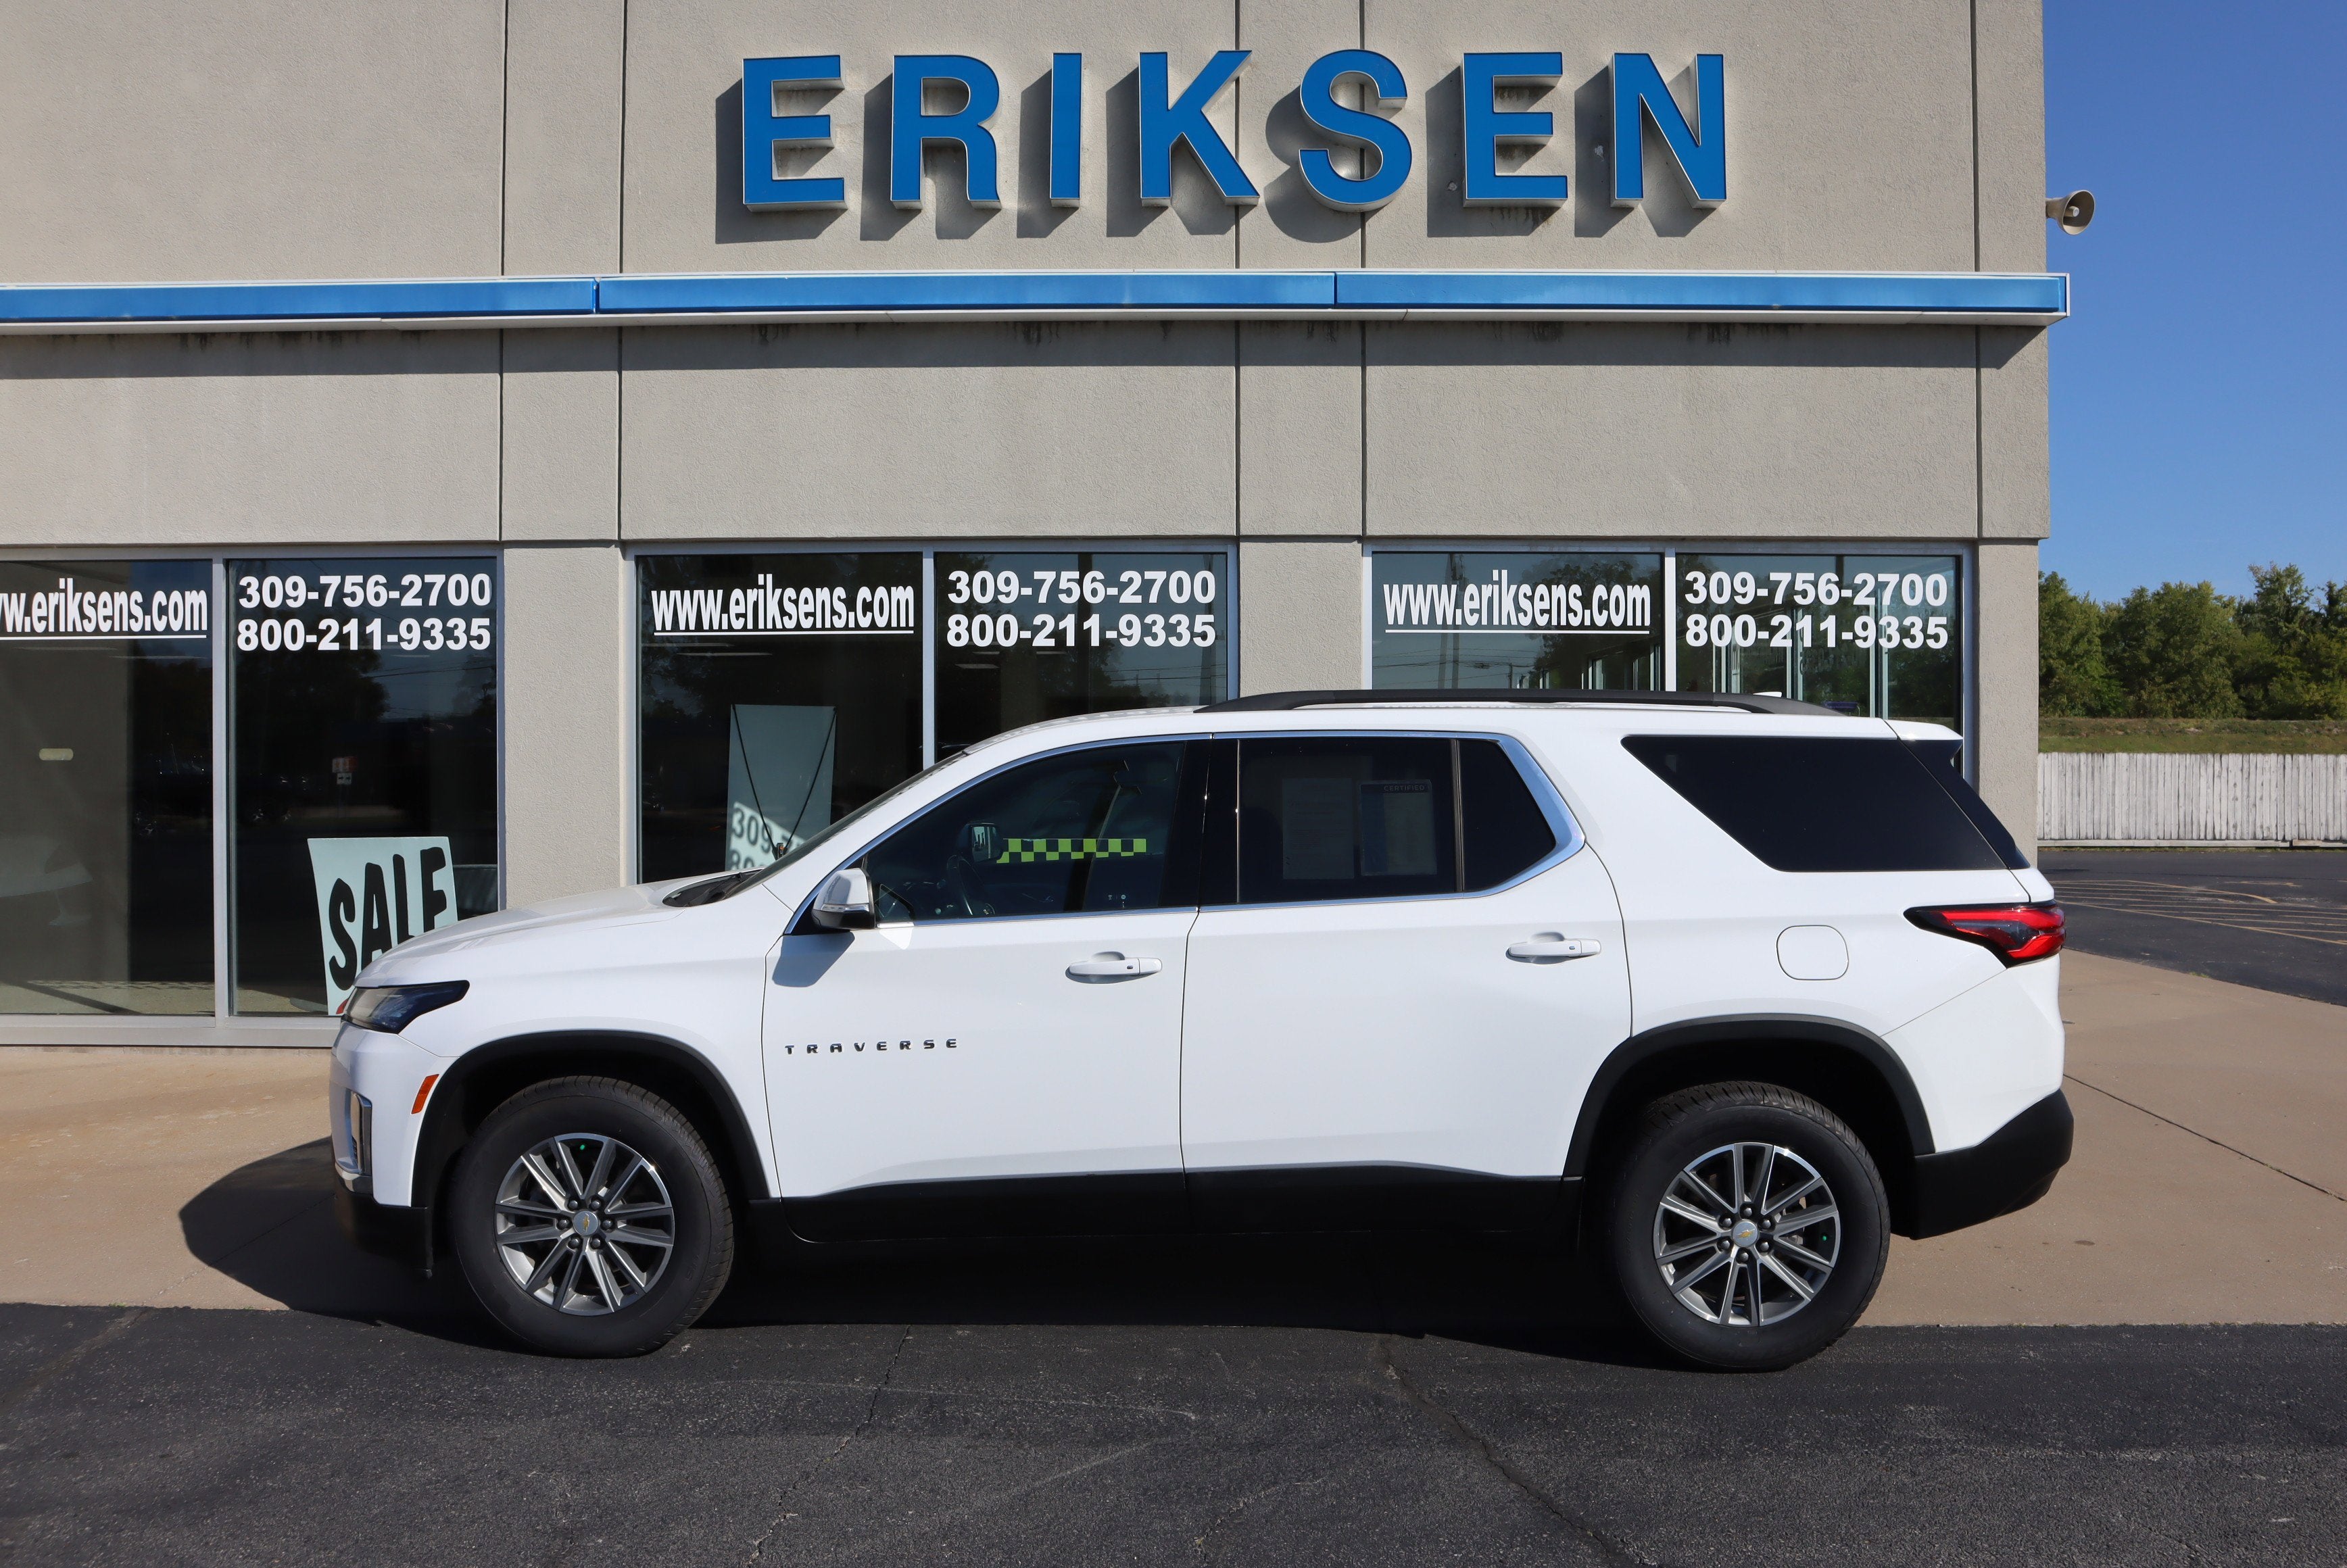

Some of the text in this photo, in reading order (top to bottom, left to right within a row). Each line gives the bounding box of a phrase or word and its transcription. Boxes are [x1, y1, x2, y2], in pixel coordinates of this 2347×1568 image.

[743, 49, 1726, 211] ERIKSEN
[0, 578, 208, 633] w.eriksens.com
[239, 573, 491, 609] 309-756-2700
[651, 574, 915, 631] www.eriksens.com
[948, 570, 1216, 604] 309-756-2700
[1383, 570, 1651, 627] www.eriksens.com
[1685, 570, 1948, 608] 309-756-2700
[237, 618, 491, 652] 800-211-9335
[946, 614, 1216, 647] 800-211-9335
[1685, 614, 1949, 650] 800-211-9335
[329, 847, 447, 991] SALE
[784, 1038, 957, 1054] TRAVERSE
